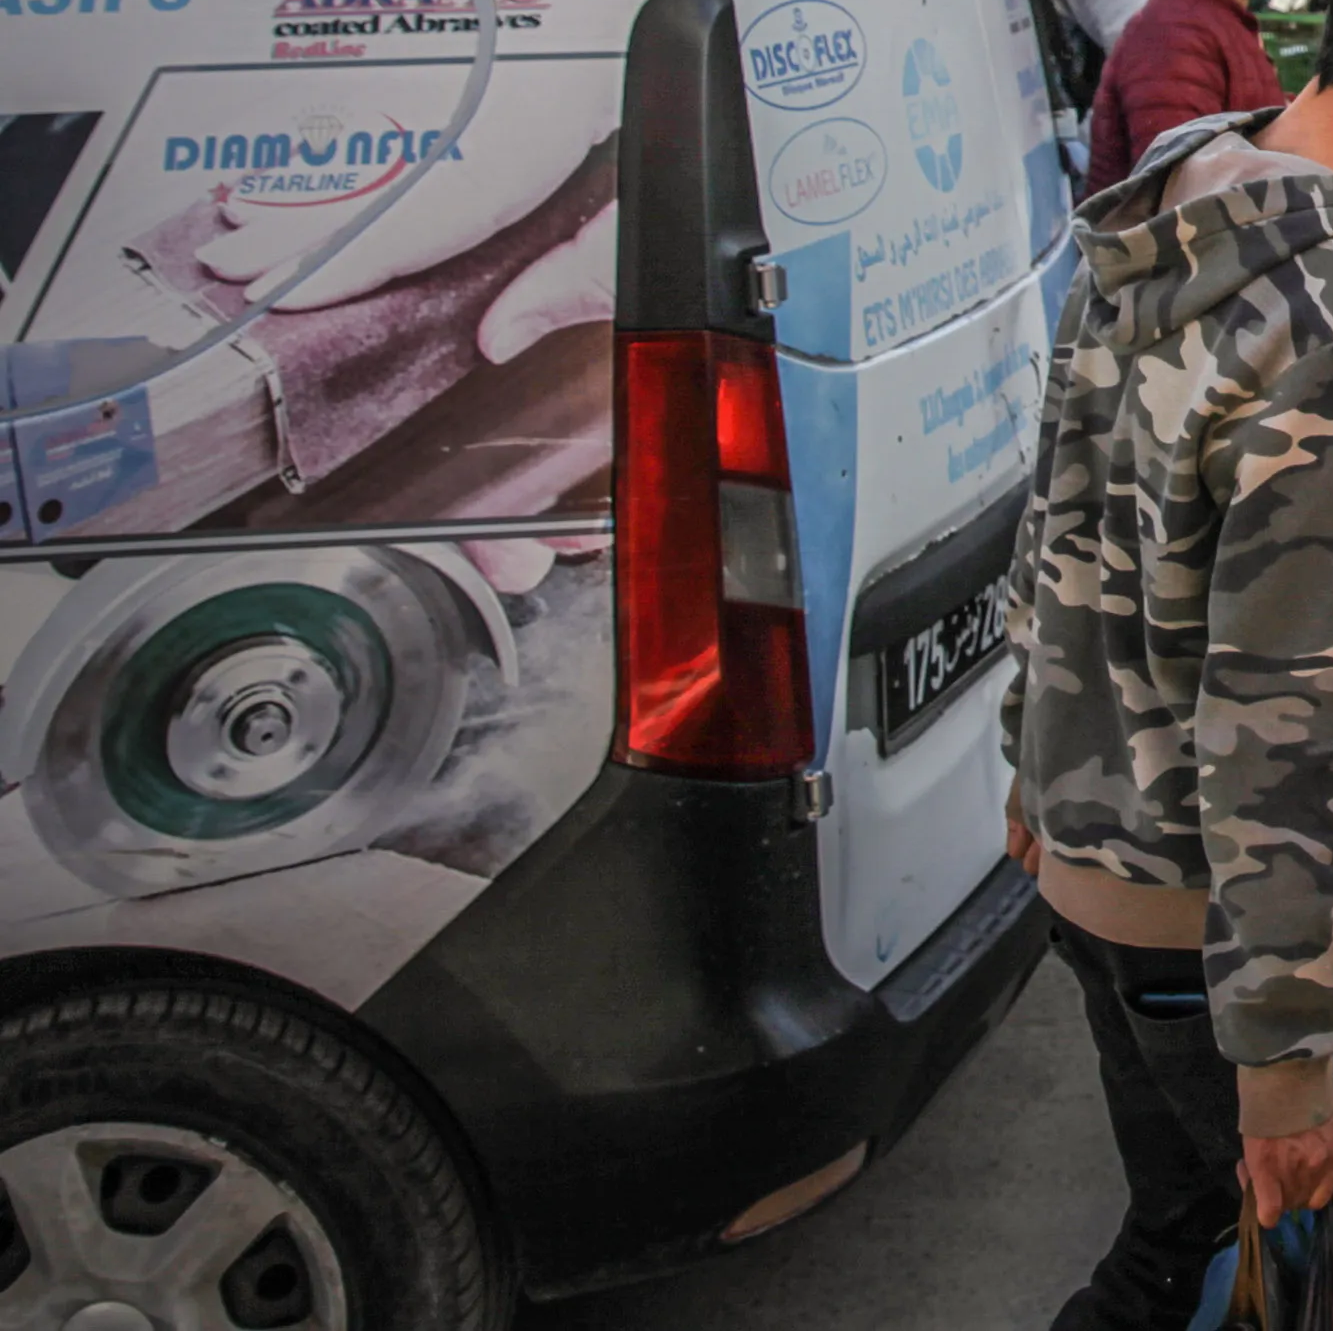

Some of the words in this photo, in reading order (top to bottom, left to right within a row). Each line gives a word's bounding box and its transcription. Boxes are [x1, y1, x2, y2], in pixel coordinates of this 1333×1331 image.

[273, 14, 380, 38] coated
[384, 13, 542, 35] Abrases
[239, 172, 359, 194] STARLINE
[785, 151, 876, 208] LAMELFLEX
[863, 297, 897, 348] ETS
[903, 618, 945, 711] 175
